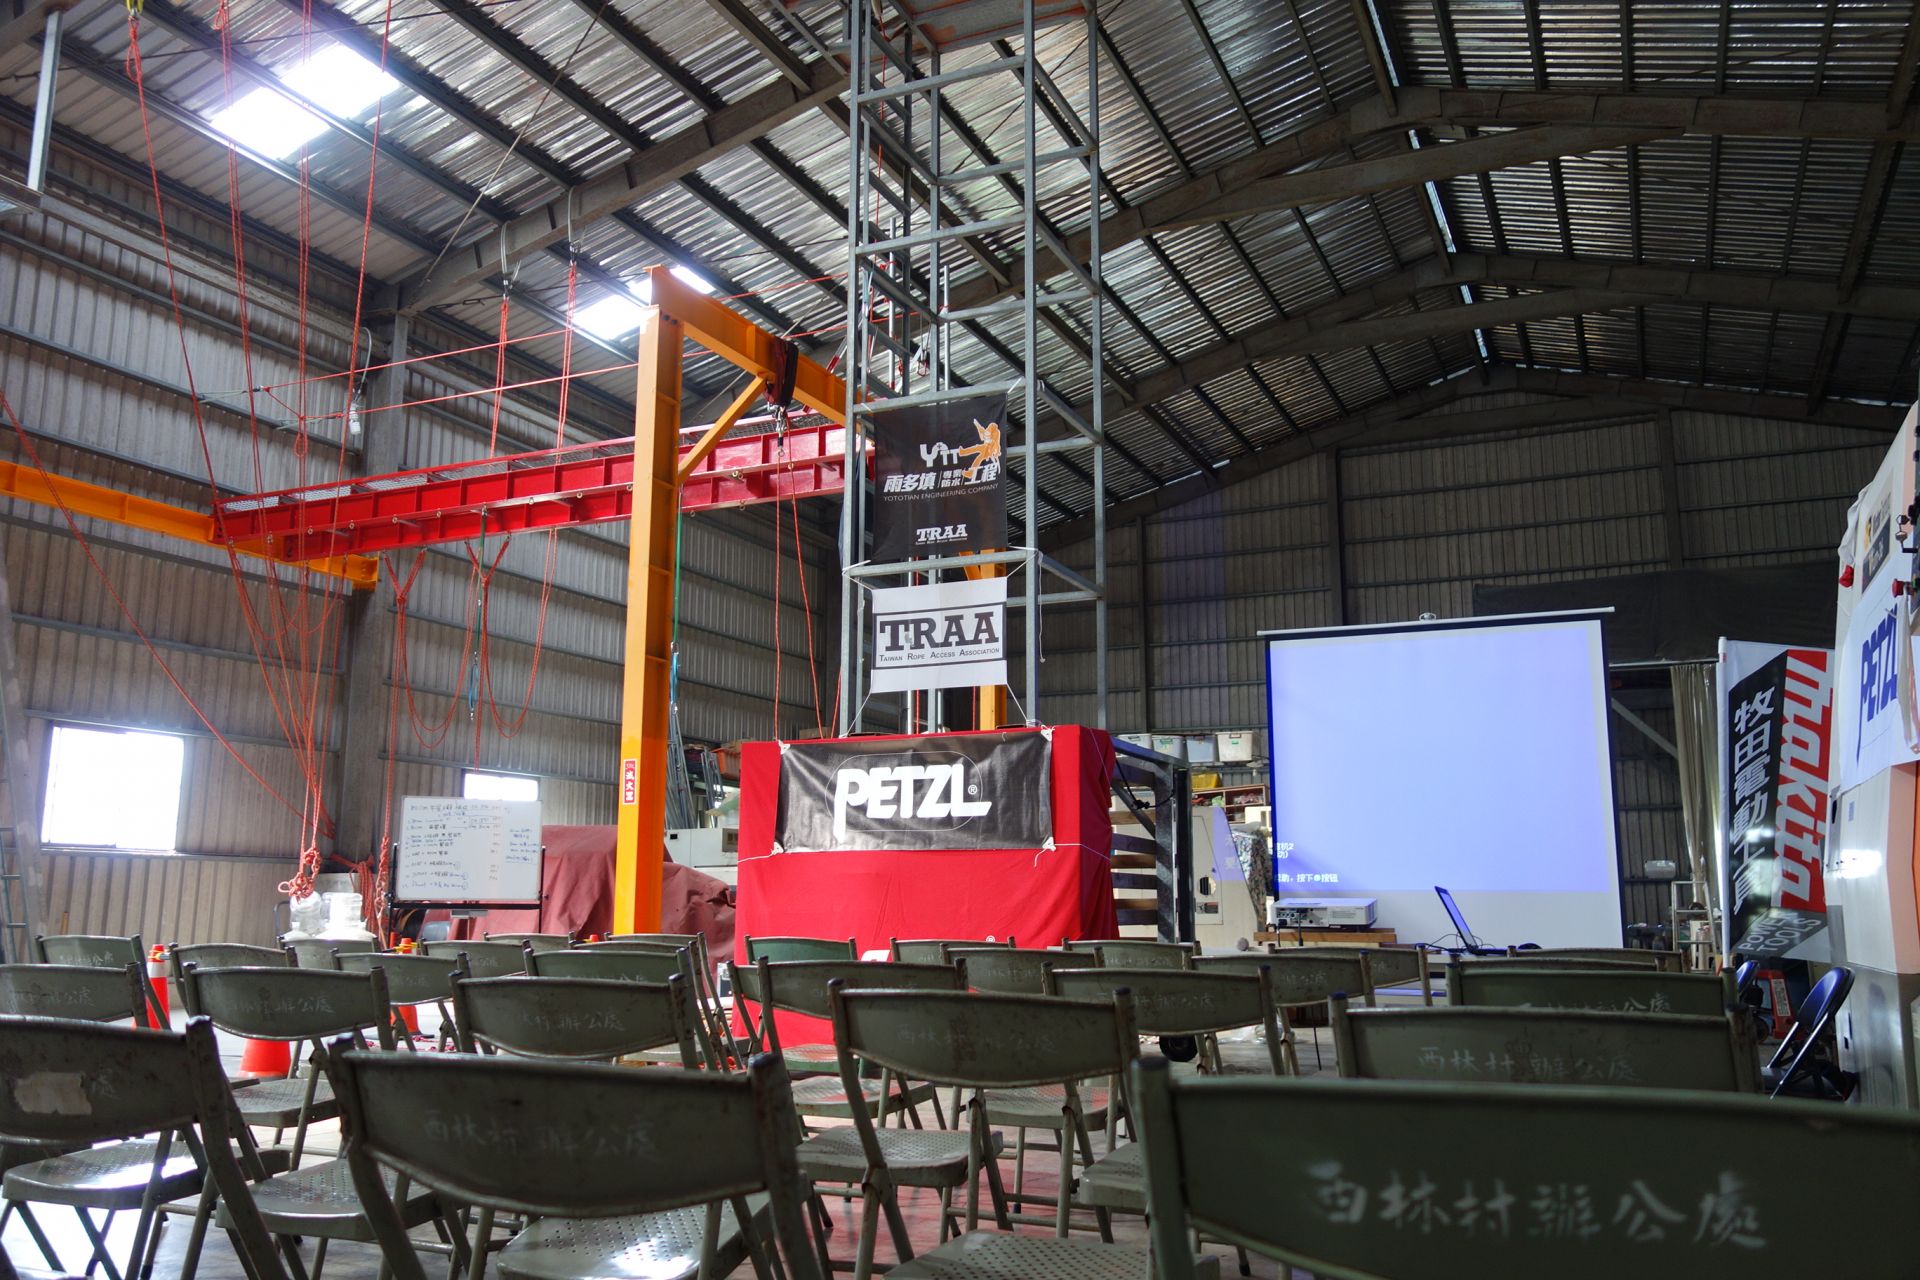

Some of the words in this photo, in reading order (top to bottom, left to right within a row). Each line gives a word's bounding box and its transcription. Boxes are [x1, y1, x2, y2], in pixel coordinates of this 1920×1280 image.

[884, 472, 937, 493] 雨多填
[941, 478, 961, 488] 防水
[964, 463, 998, 485] 工程
[883, 494, 920, 502] YOTOTIAN
[921, 488, 967, 500] ENGINEERING
[967, 483, 999, 495] COMPANY
[916, 524, 968, 542] TRAA
[880, 611, 1000, 652] TRAA
[1857, 603, 1897, 767] PETZL
[1771, 650, 1834, 908] makita
[833, 764, 992, 843] PETZL
[1738, 911, 1799, 951] POWER
[1756, 917, 1822, 952] TOOLS
